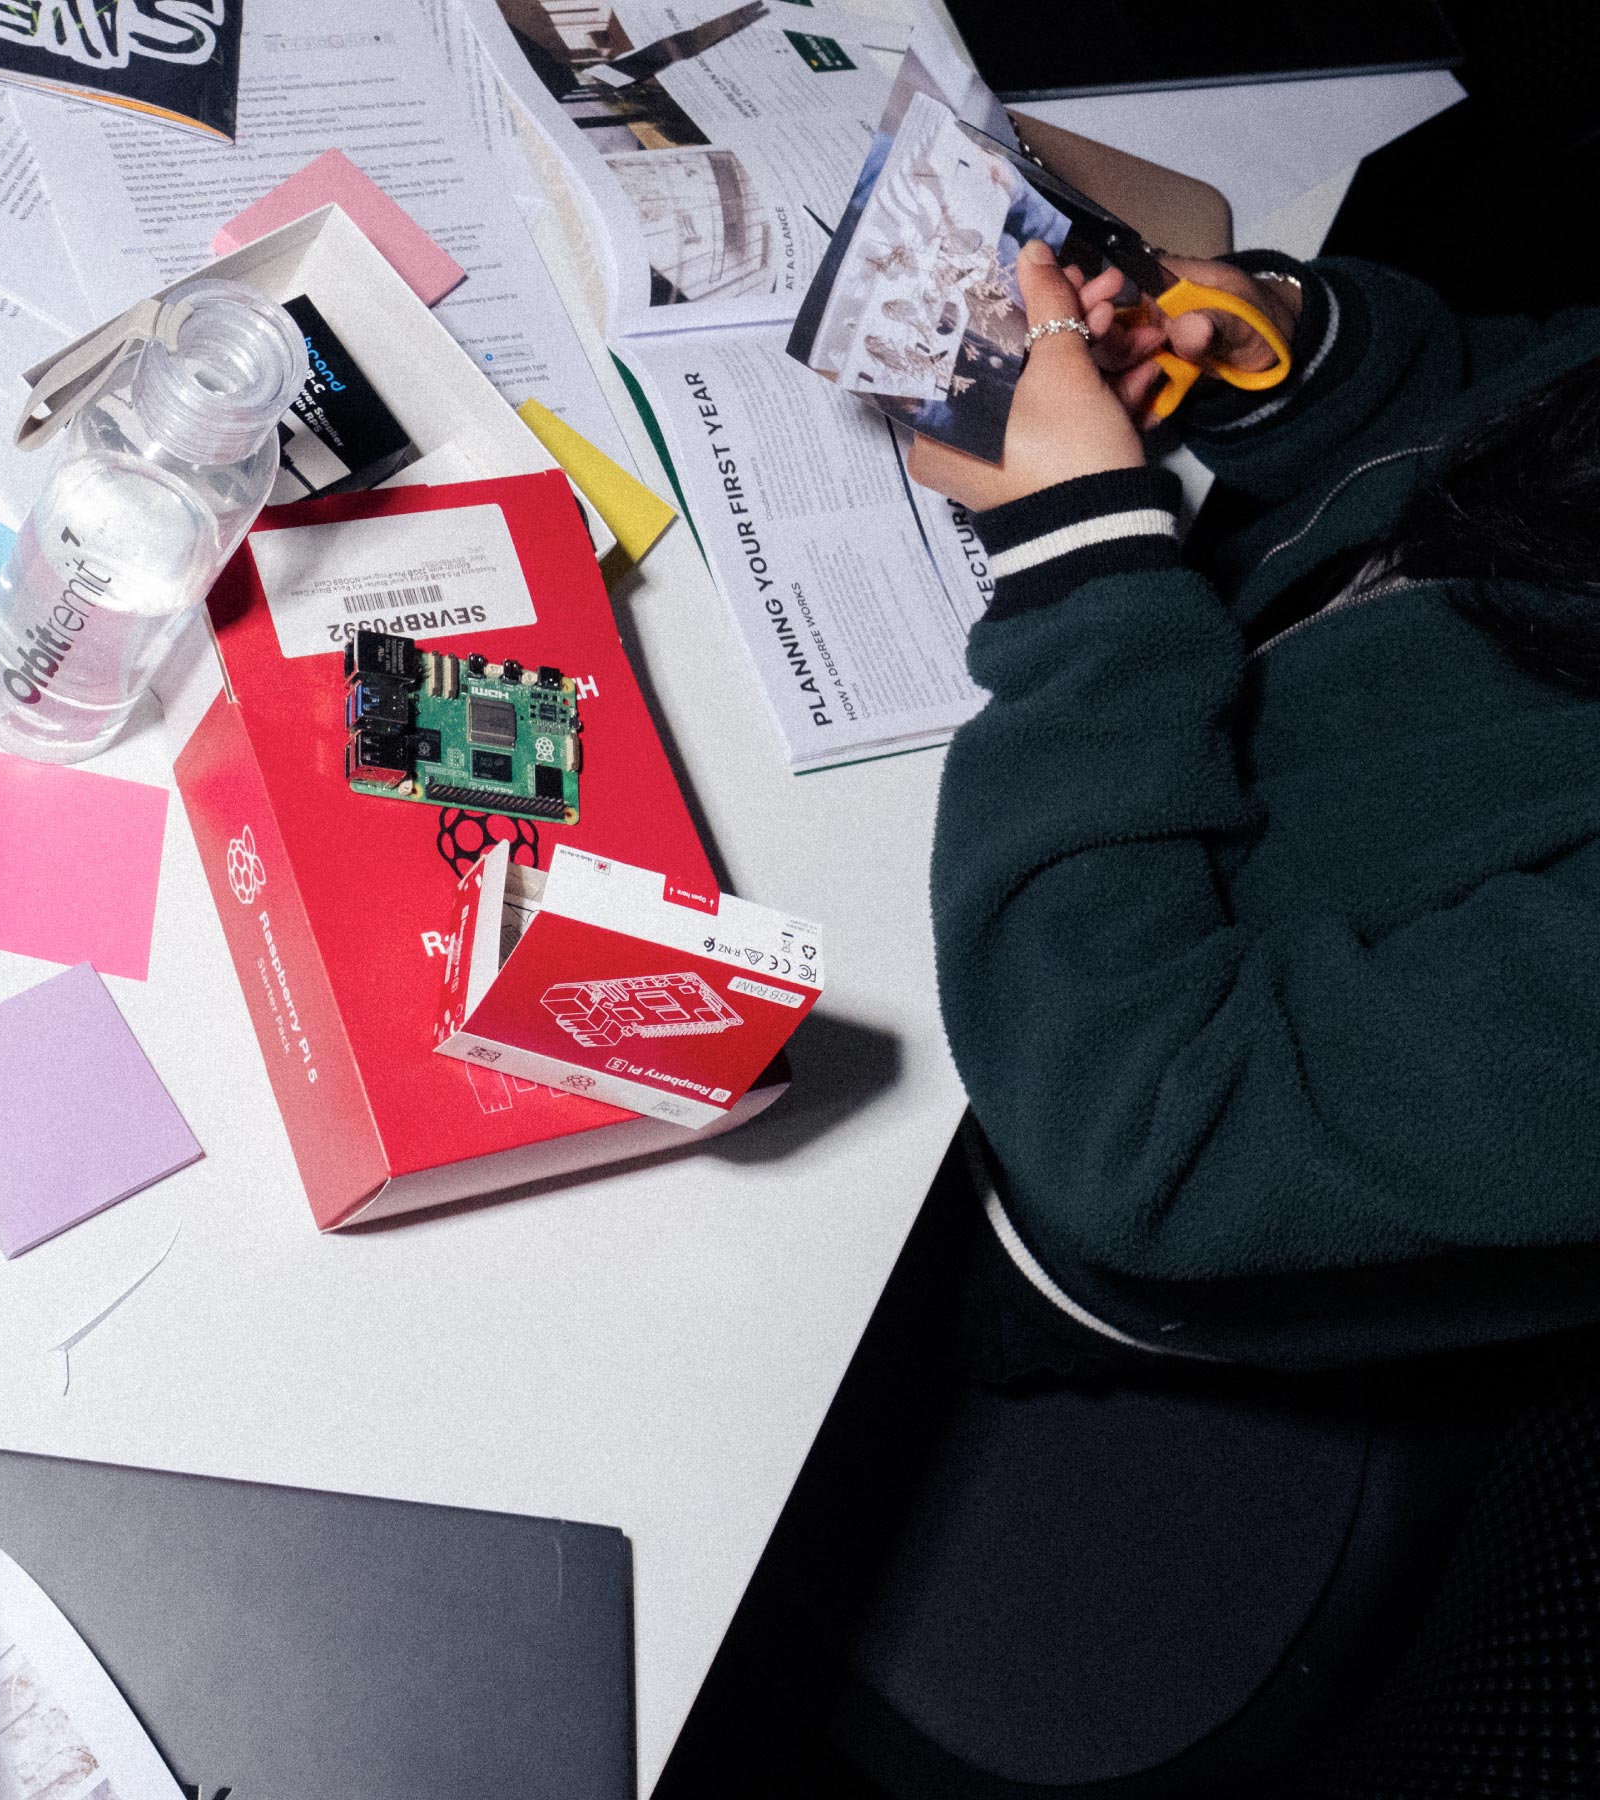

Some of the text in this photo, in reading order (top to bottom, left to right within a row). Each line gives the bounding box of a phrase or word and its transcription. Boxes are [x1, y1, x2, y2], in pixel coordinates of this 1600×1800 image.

[775, 206, 794, 290] AT A GLANCE
[313, 406, 342, 445] Supplier
[684, 372, 832, 726] PLANNING YOUR FIRST YEAR
[328, 605, 485, 641] SEVRBP0592
[790, 581, 857, 721] HOW A DEGREE WORKS
[470, 686, 508, 700] HDMI
[676, 888, 706, 903] Open here
[257, 957, 292, 1055] Starter Pack
[258, 911, 320, 1085] Raspberry Pi 5
[735, 979, 800, 1008] 4GB RAM
[608, 1058, 711, 1095] Raspberry Pi 5
